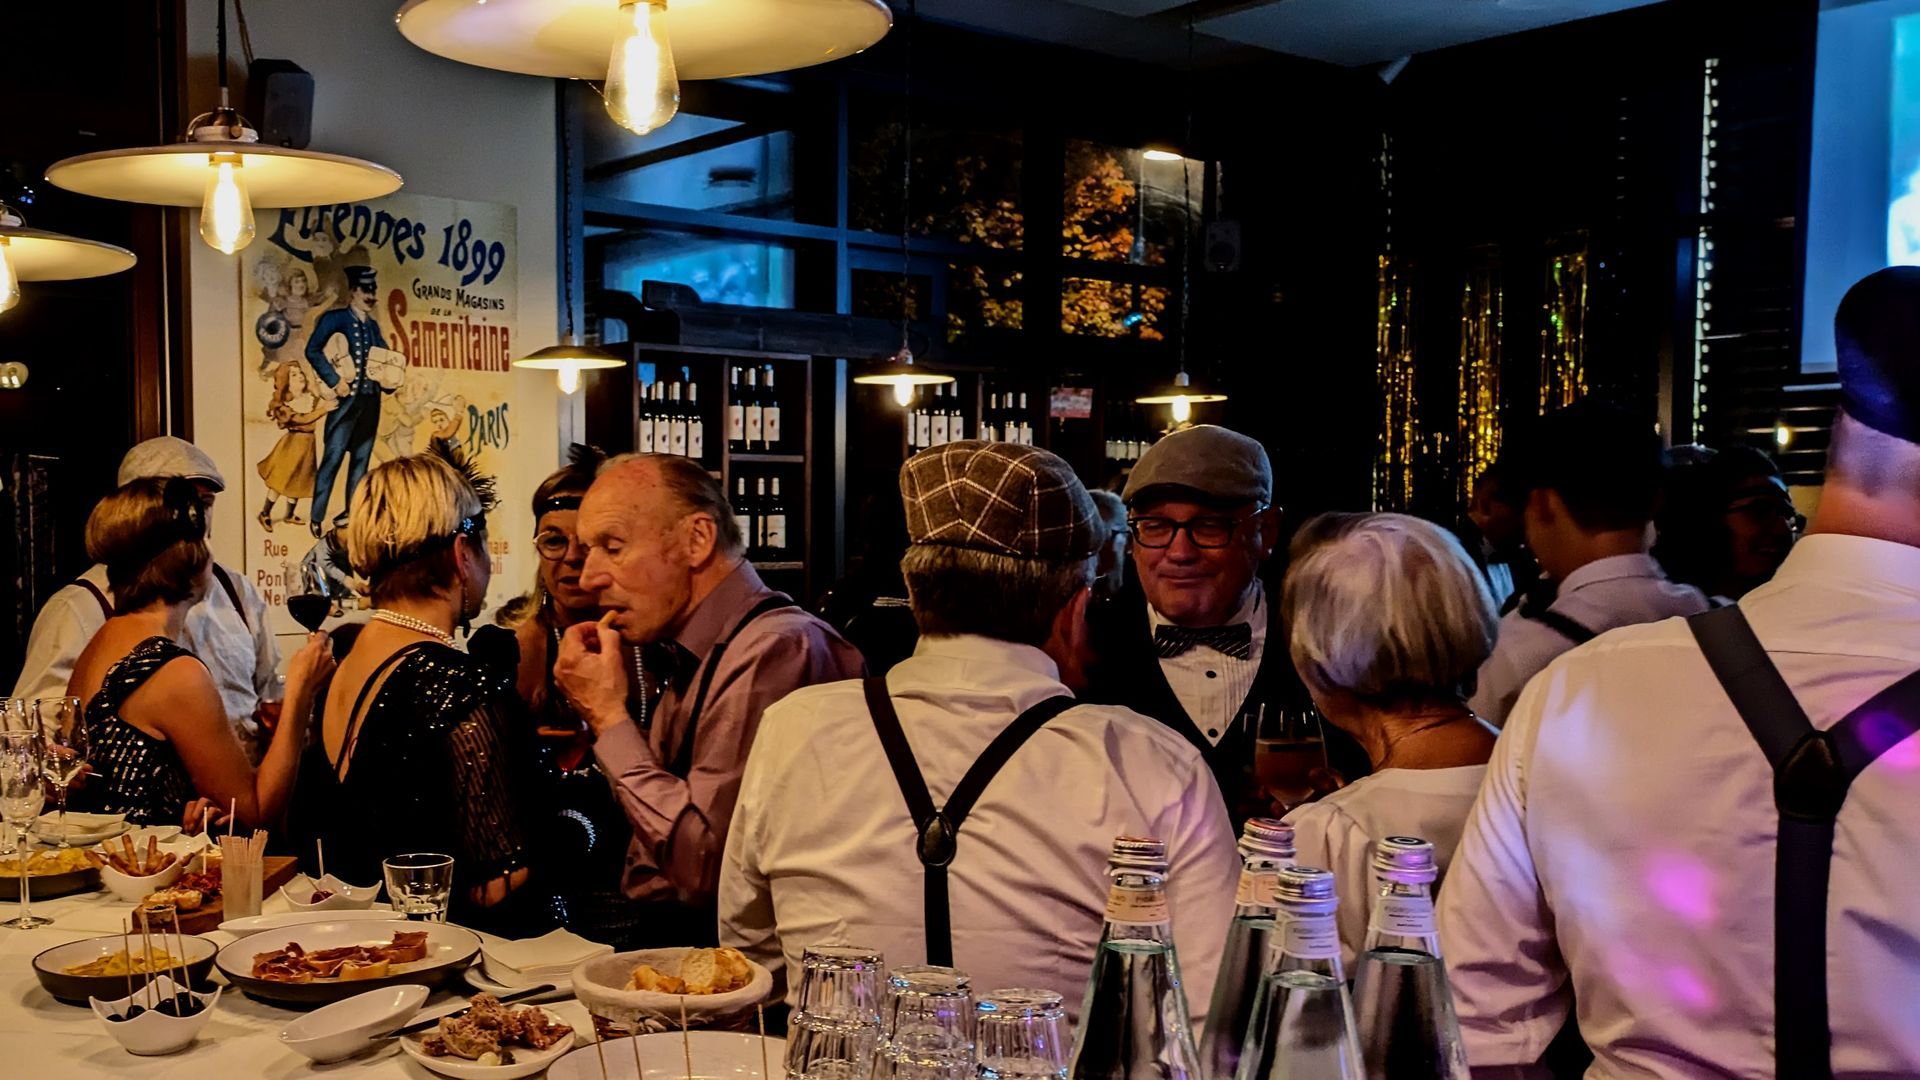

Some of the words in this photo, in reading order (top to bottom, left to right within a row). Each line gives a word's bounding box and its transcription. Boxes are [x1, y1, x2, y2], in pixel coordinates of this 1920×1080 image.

[437, 218, 506, 287] 1899
[412, 277, 452, 300] GRANDS
[455, 288, 505, 311] MAGASINS
[430, 307, 441, 316] DE
[388, 288, 510, 373] Samaritaine
[464, 402, 509, 457] PARIS
[264, 539, 288, 557] Rue
